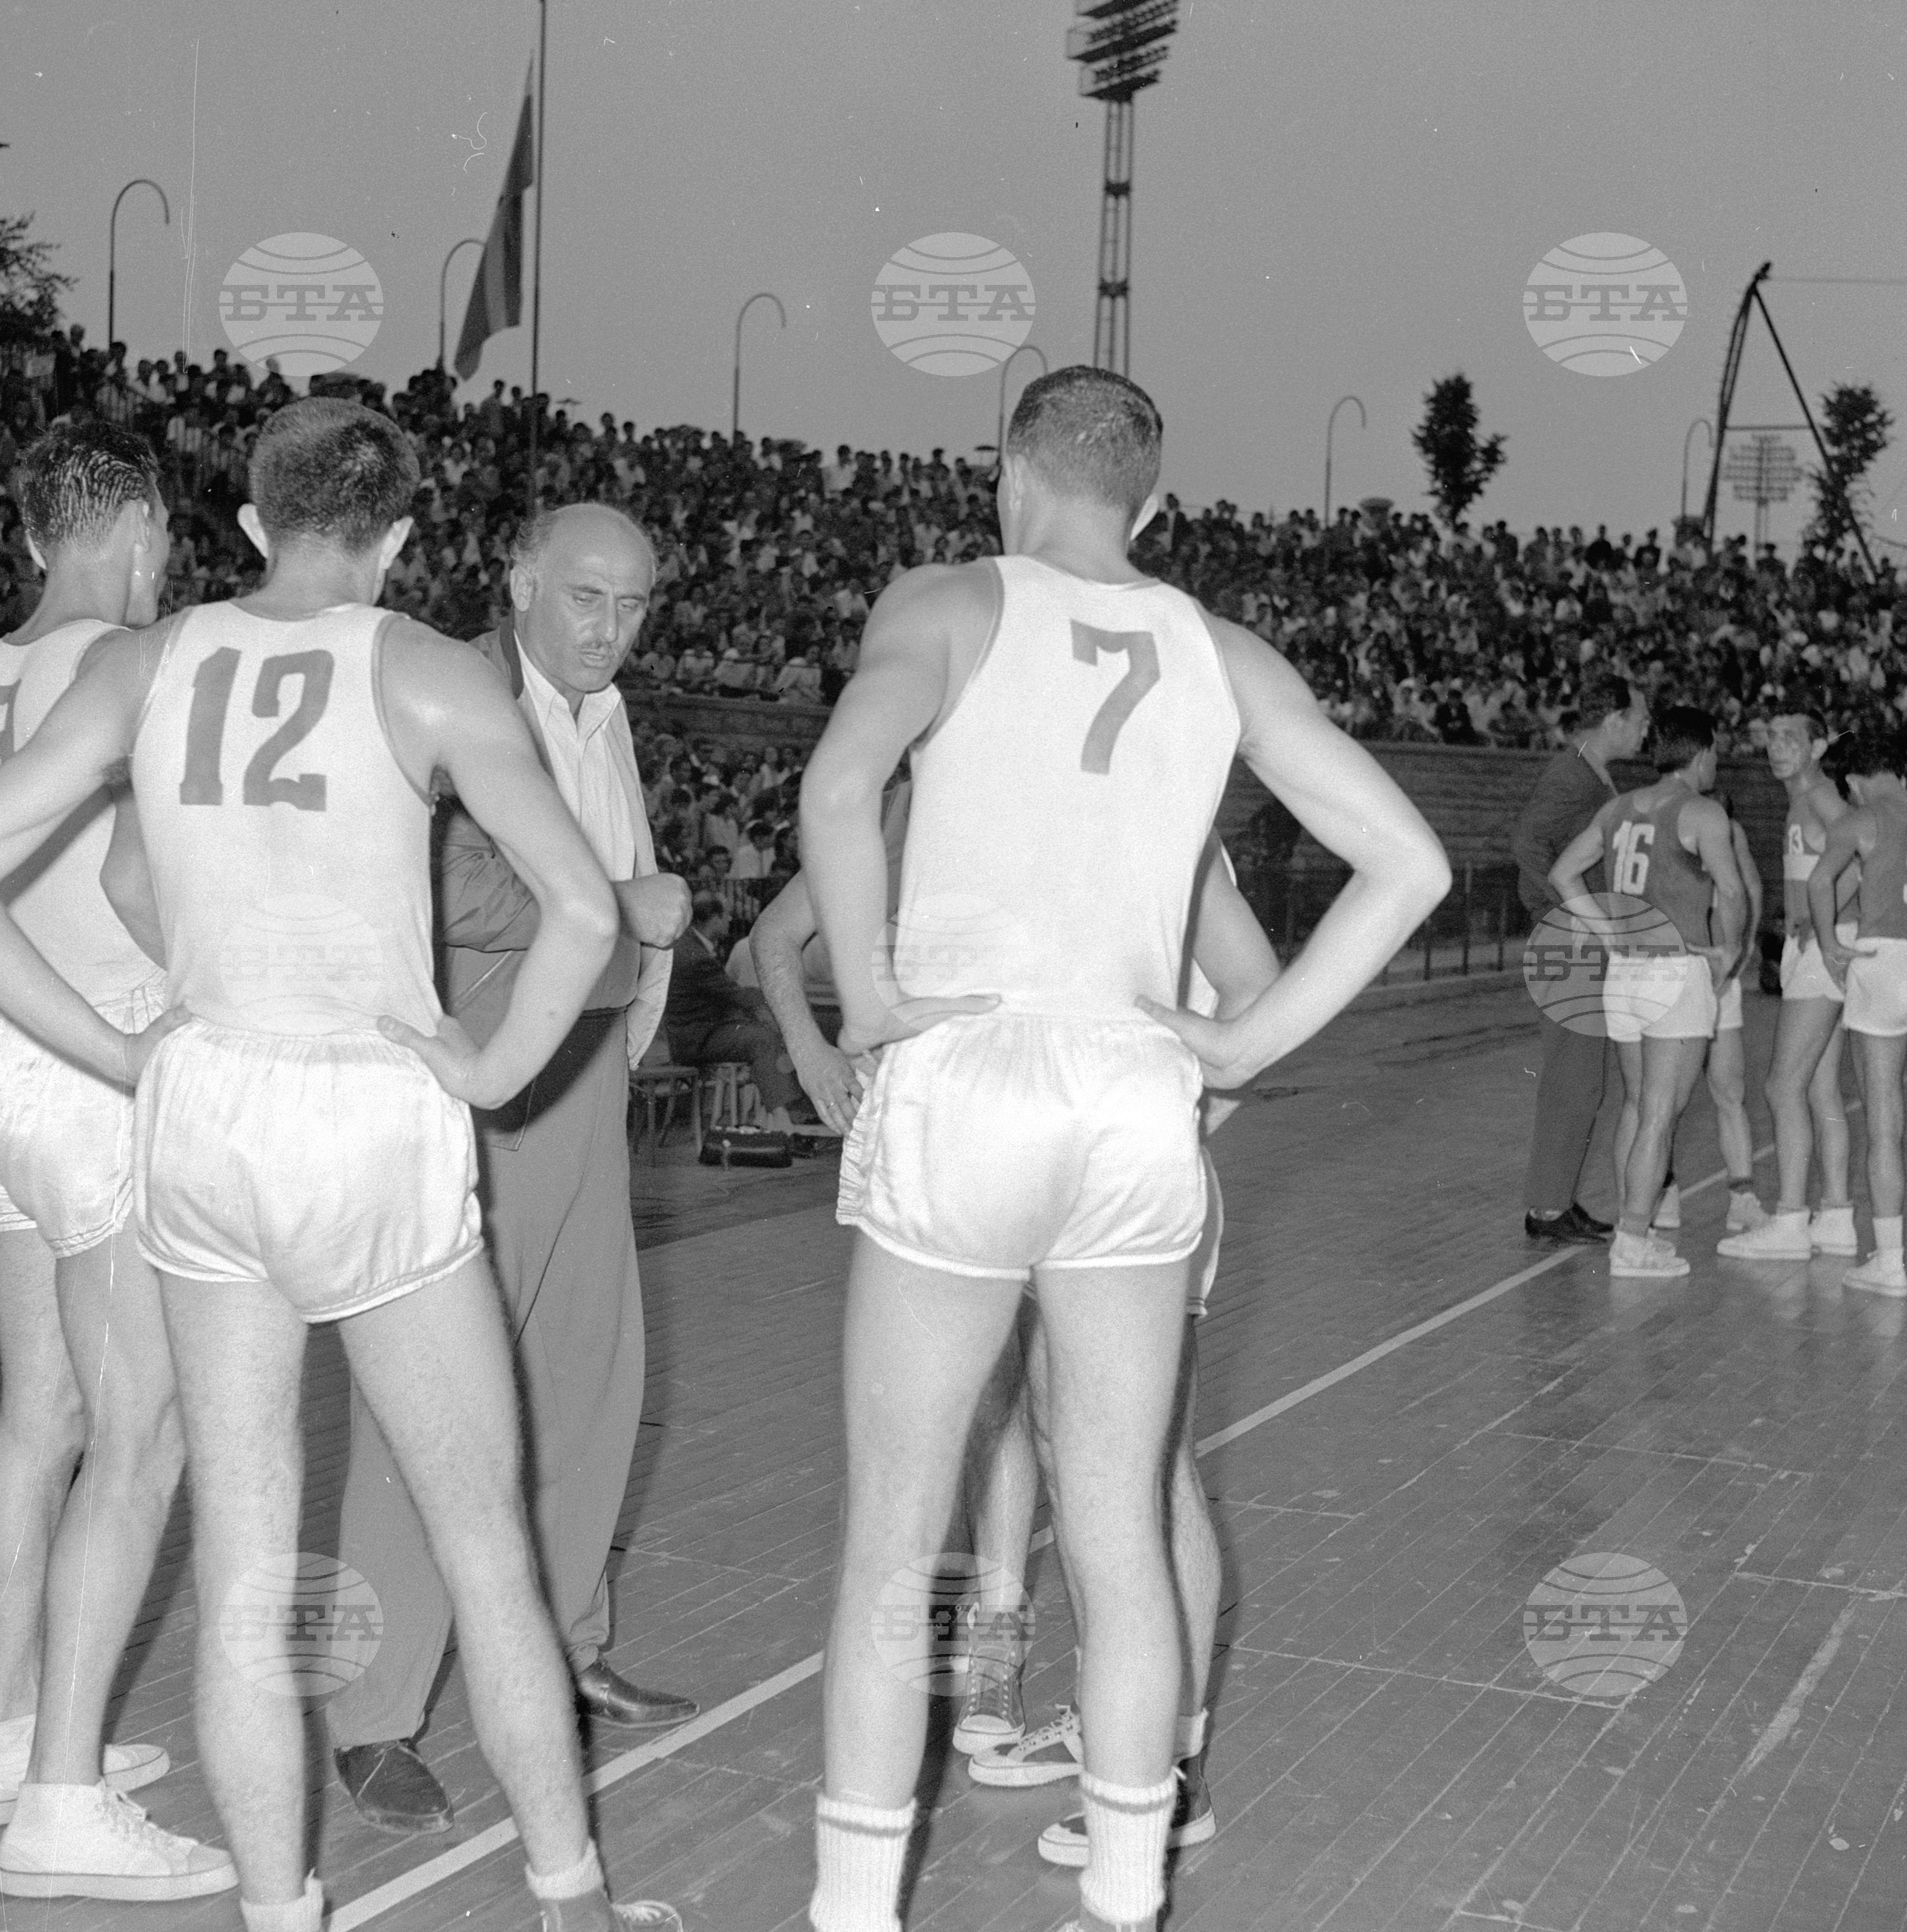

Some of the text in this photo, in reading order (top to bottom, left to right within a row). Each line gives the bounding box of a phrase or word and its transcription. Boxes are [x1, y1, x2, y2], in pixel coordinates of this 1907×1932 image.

[179, 646, 334, 811] 12
[1070, 619, 1160, 776] 7
[1612, 820, 1655, 895] 16
